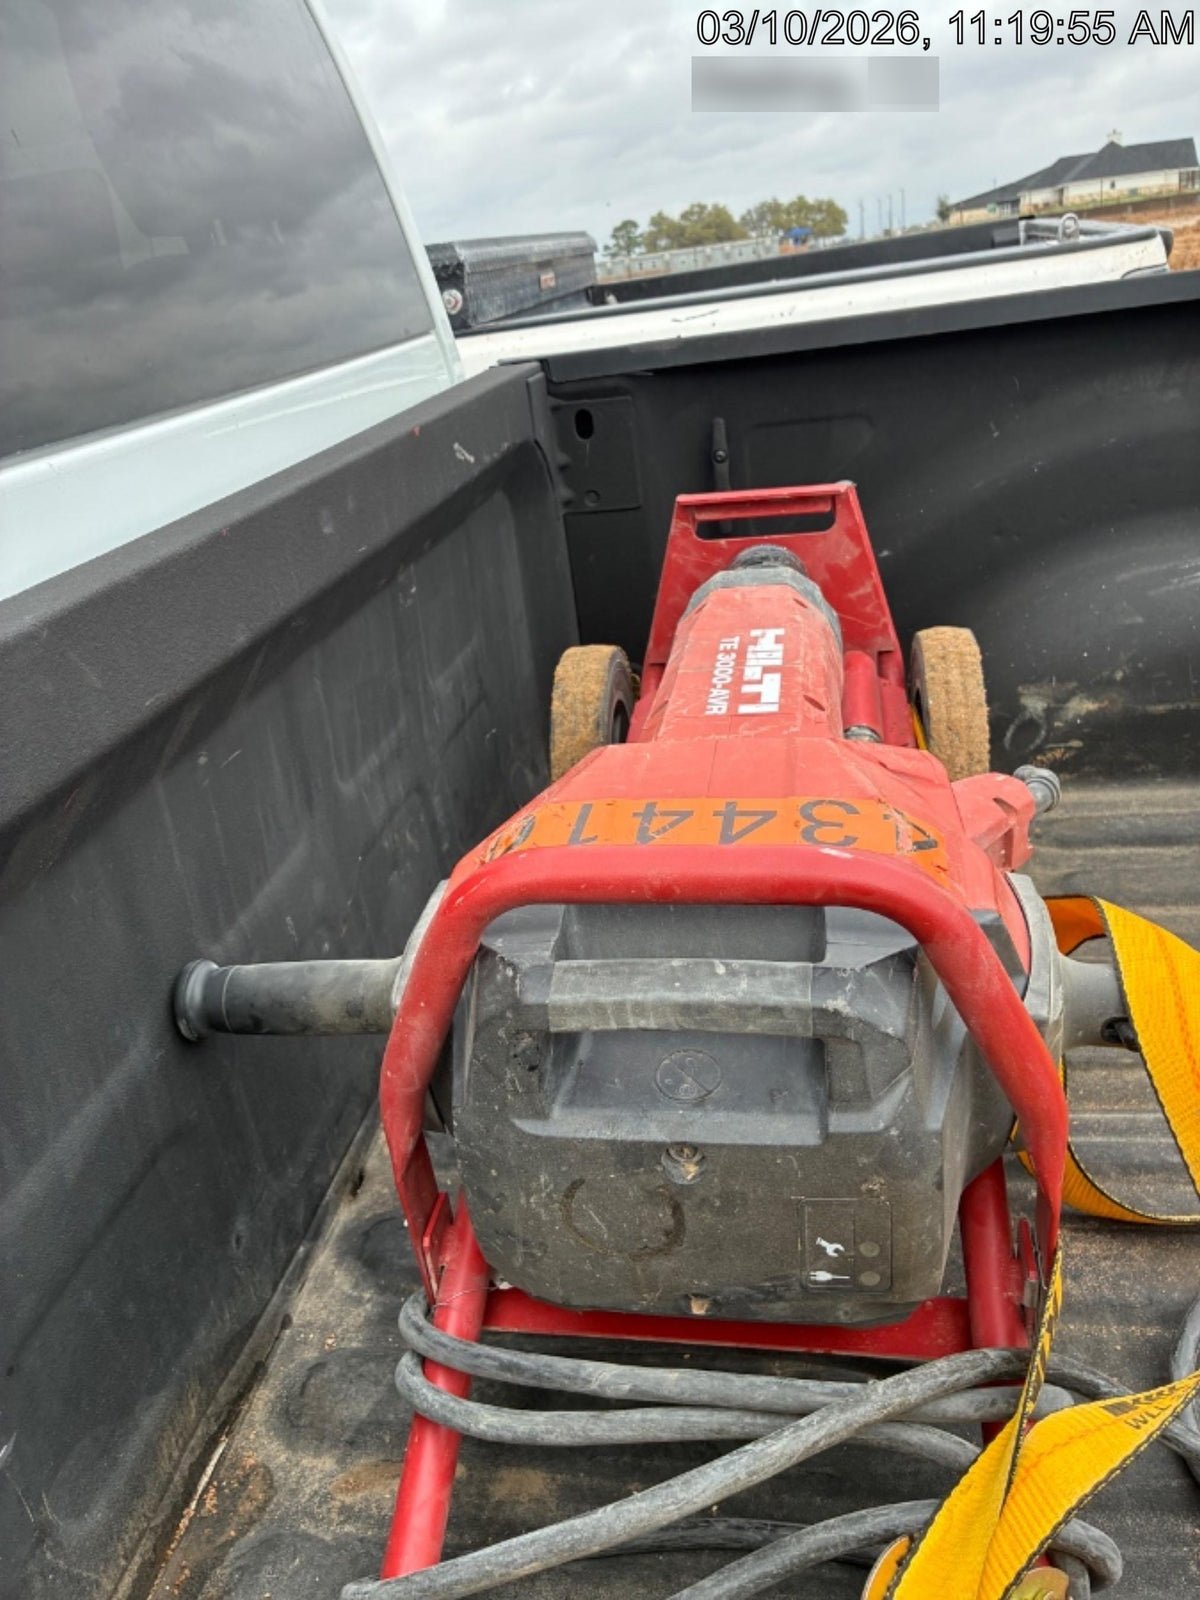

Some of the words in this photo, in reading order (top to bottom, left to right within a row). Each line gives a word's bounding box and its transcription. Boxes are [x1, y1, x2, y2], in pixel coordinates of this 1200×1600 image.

[718, 635, 740, 652] TE
[737, 627, 785, 715] HILTI
[704, 651, 737, 716] 3000-AVR
